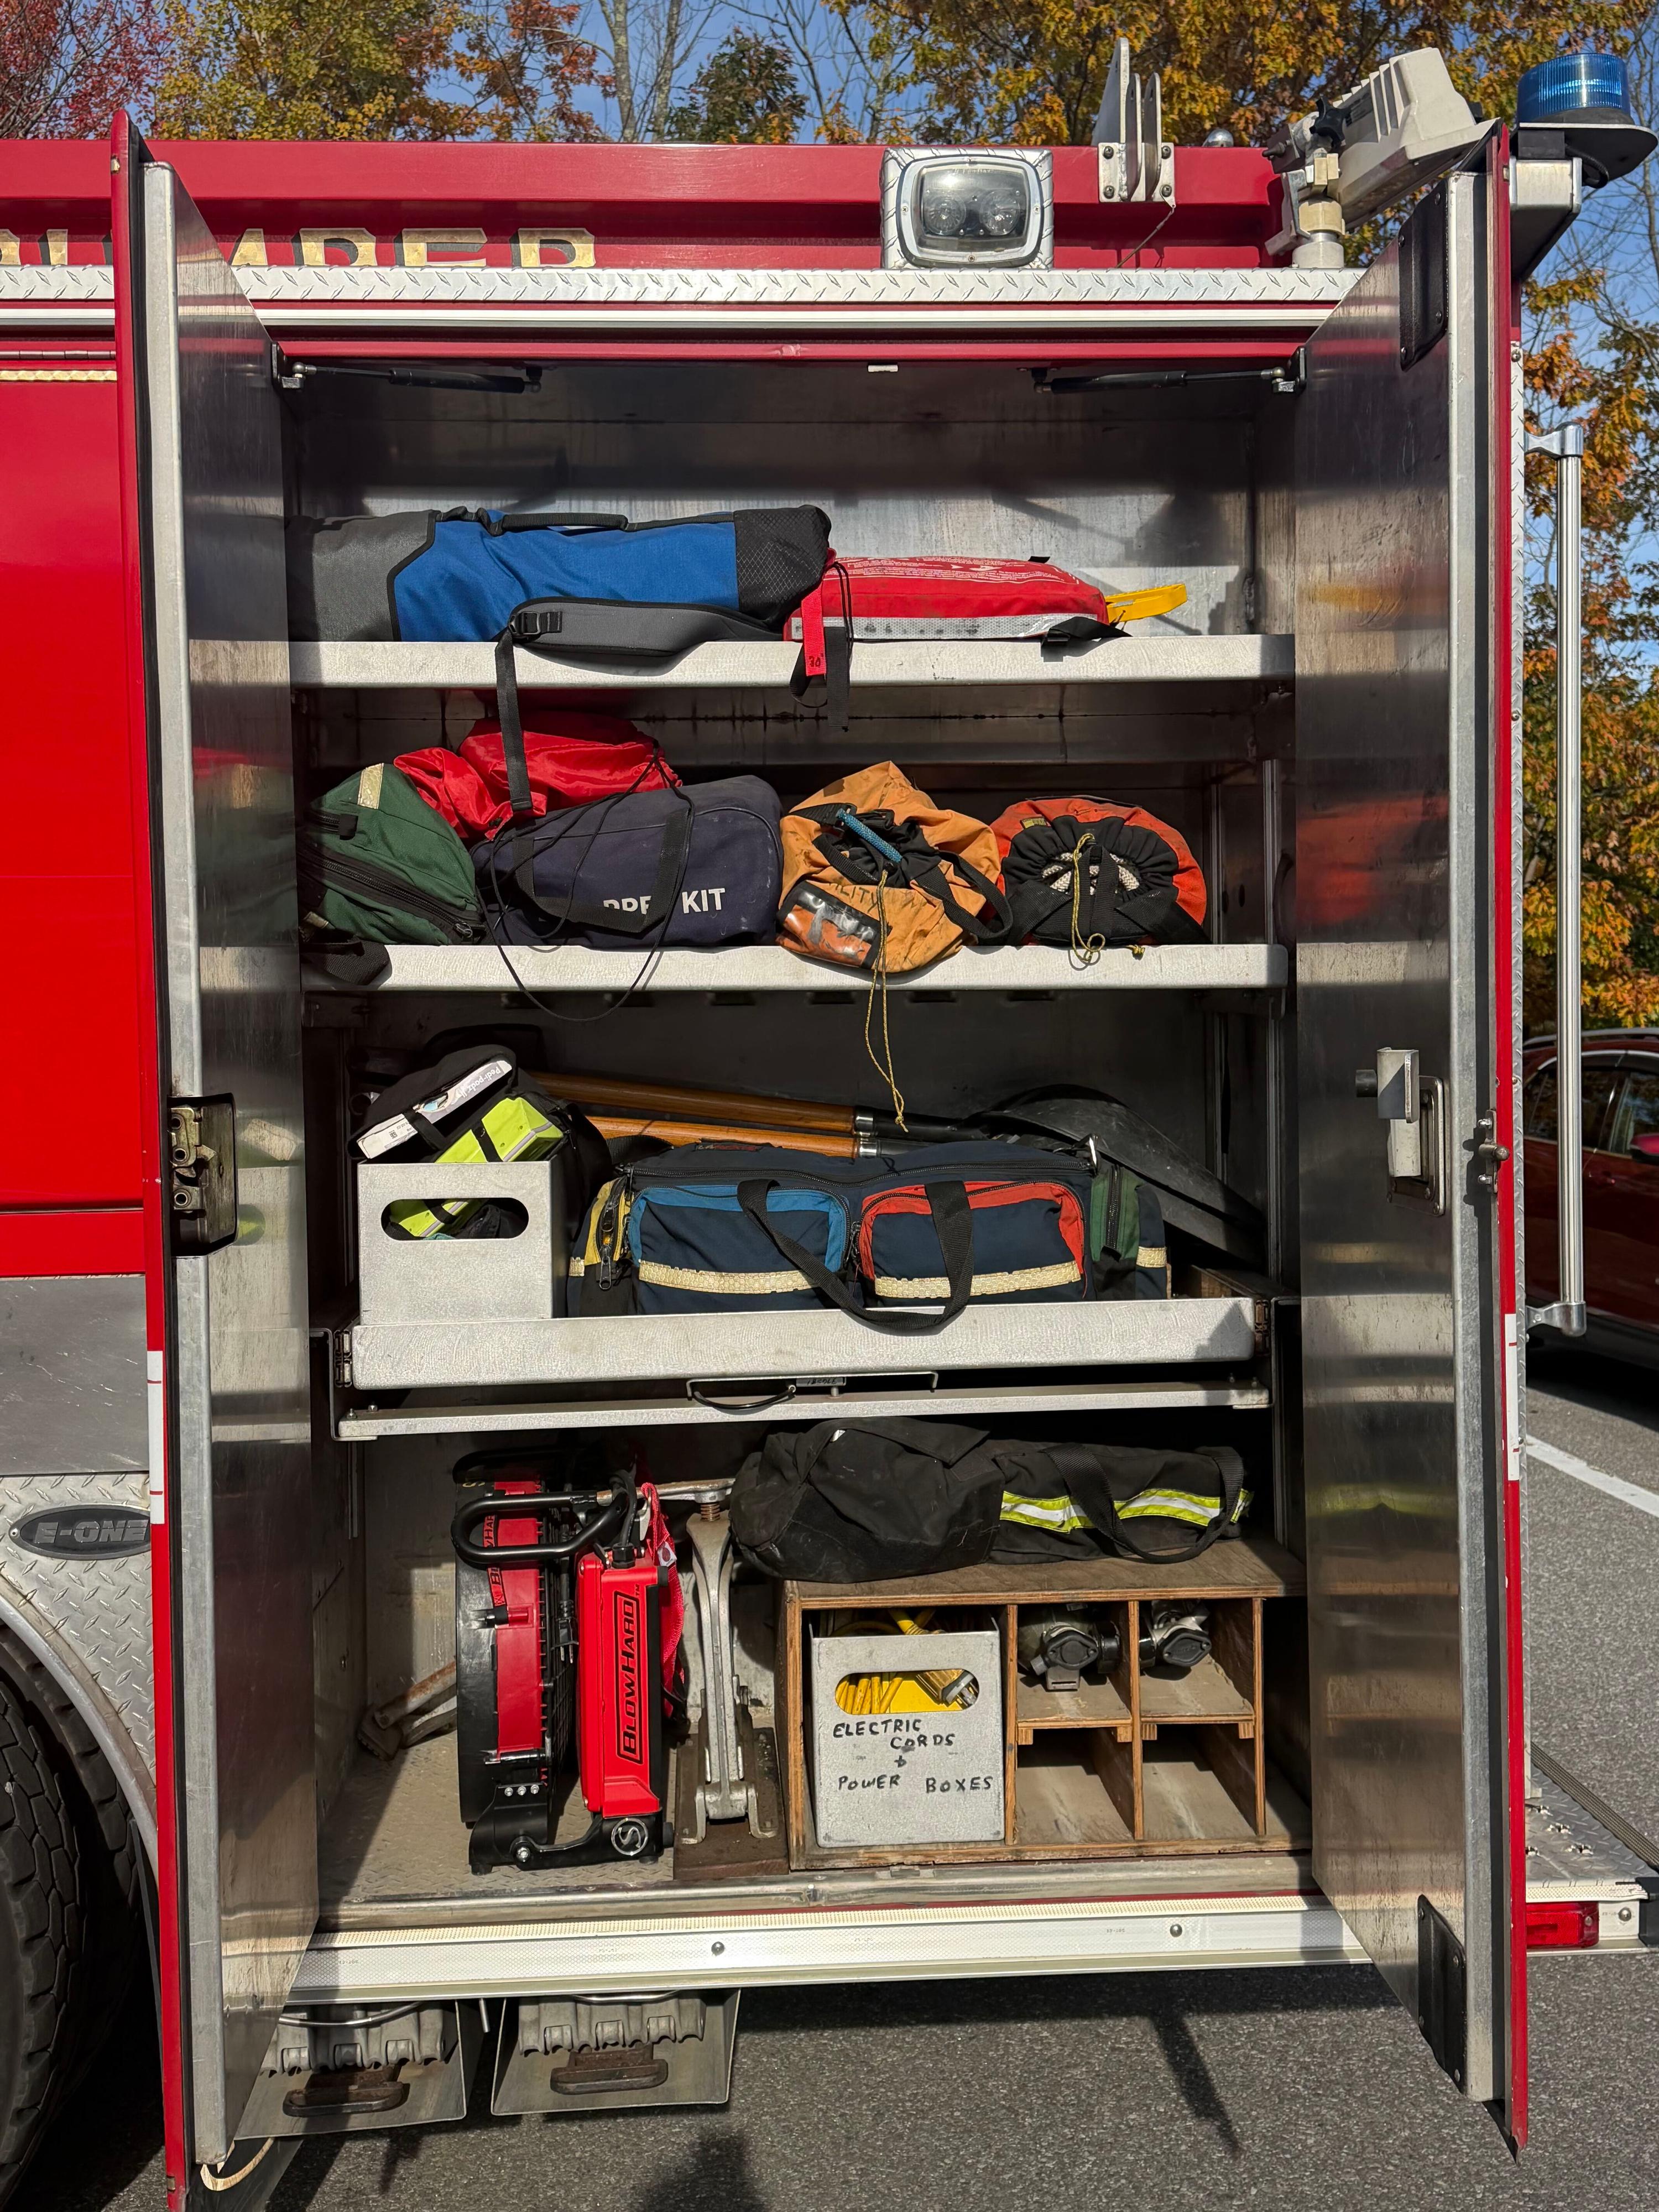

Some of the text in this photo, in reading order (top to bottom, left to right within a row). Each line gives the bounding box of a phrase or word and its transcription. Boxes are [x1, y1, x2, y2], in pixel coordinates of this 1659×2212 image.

[682, 888, 726, 914] KIT
[467, 1066, 501, 1093] Pedi-padz
[34, 1519, 149, 1544] E-ONE
[833, 1718, 922, 1738] ELECTRIC
[890, 1733, 956, 1750] CORDS
[838, 1774, 993, 1794] POWER BOXES
